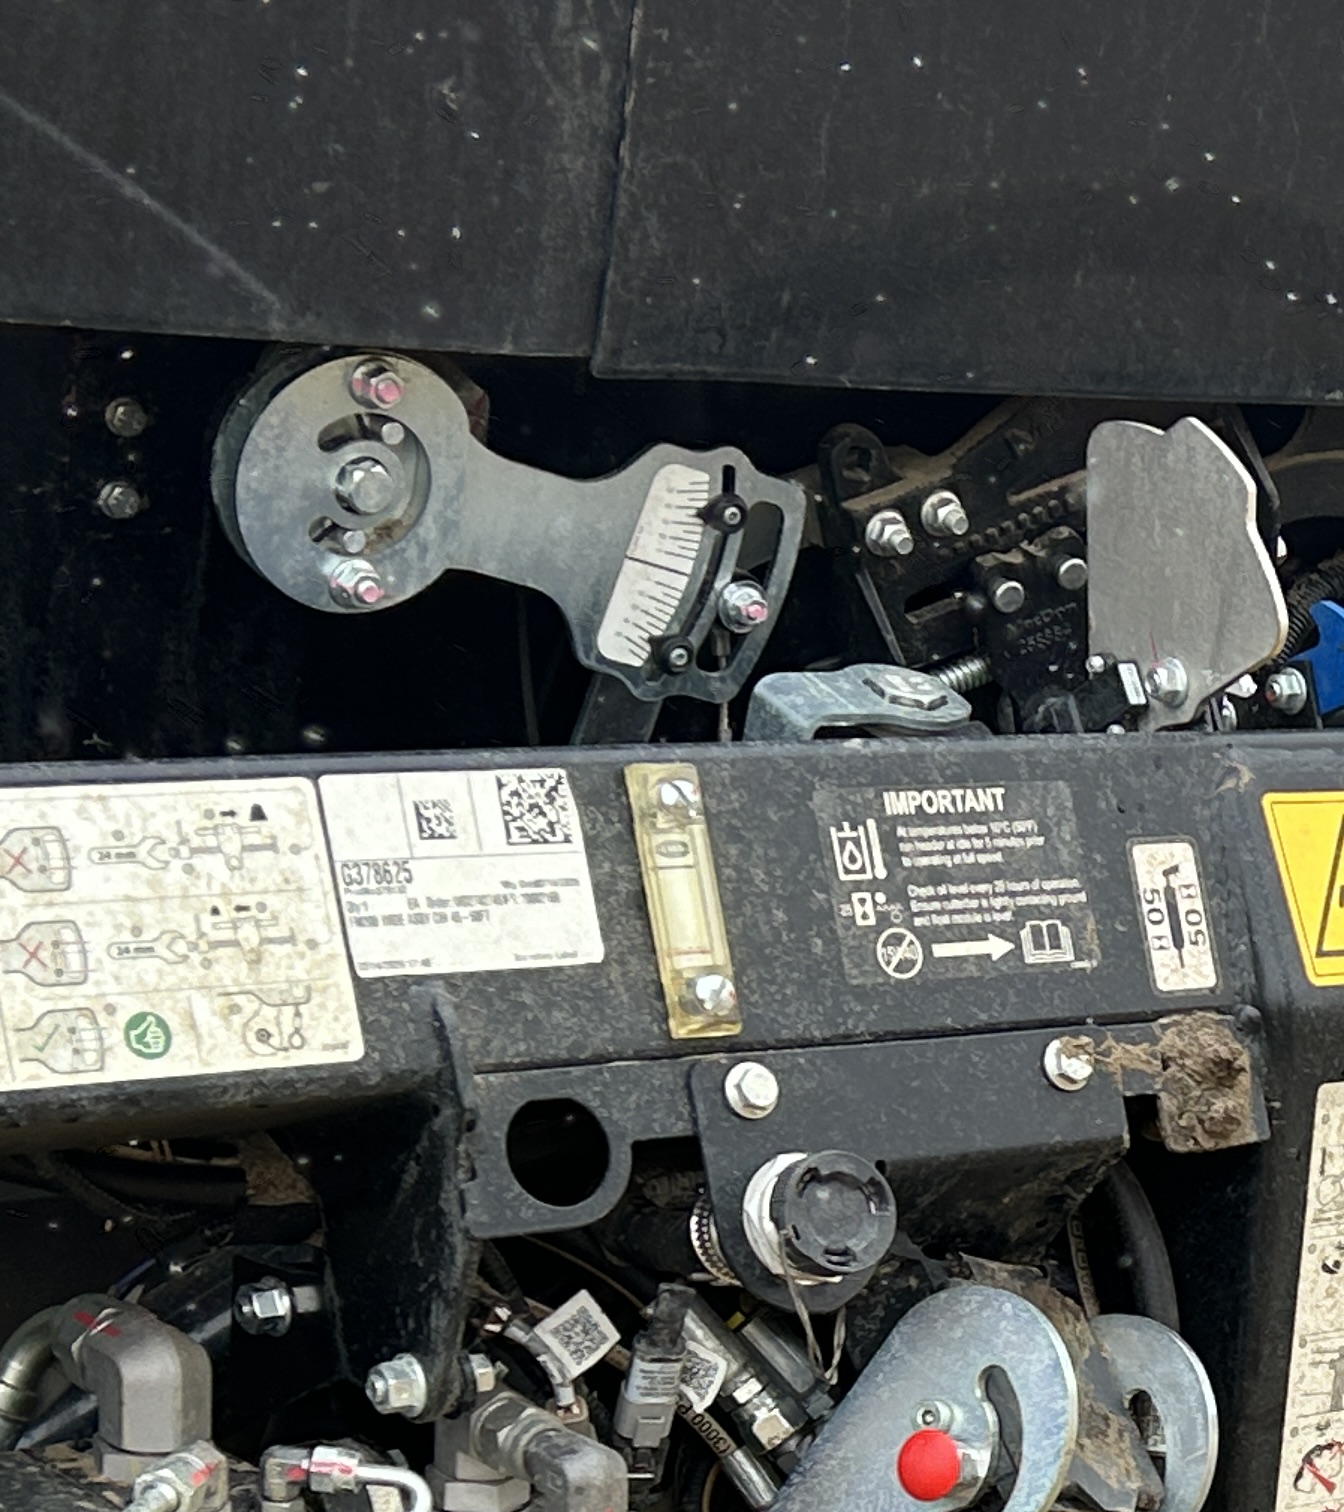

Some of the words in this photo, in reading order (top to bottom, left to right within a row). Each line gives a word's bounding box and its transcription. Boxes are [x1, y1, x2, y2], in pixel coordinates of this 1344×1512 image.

[883, 787, 1005, 815] IMPORTANT
[341, 860, 413, 887] G378625
[1143, 887, 1166, 926] 50
[1184, 908, 1207, 947] 50
